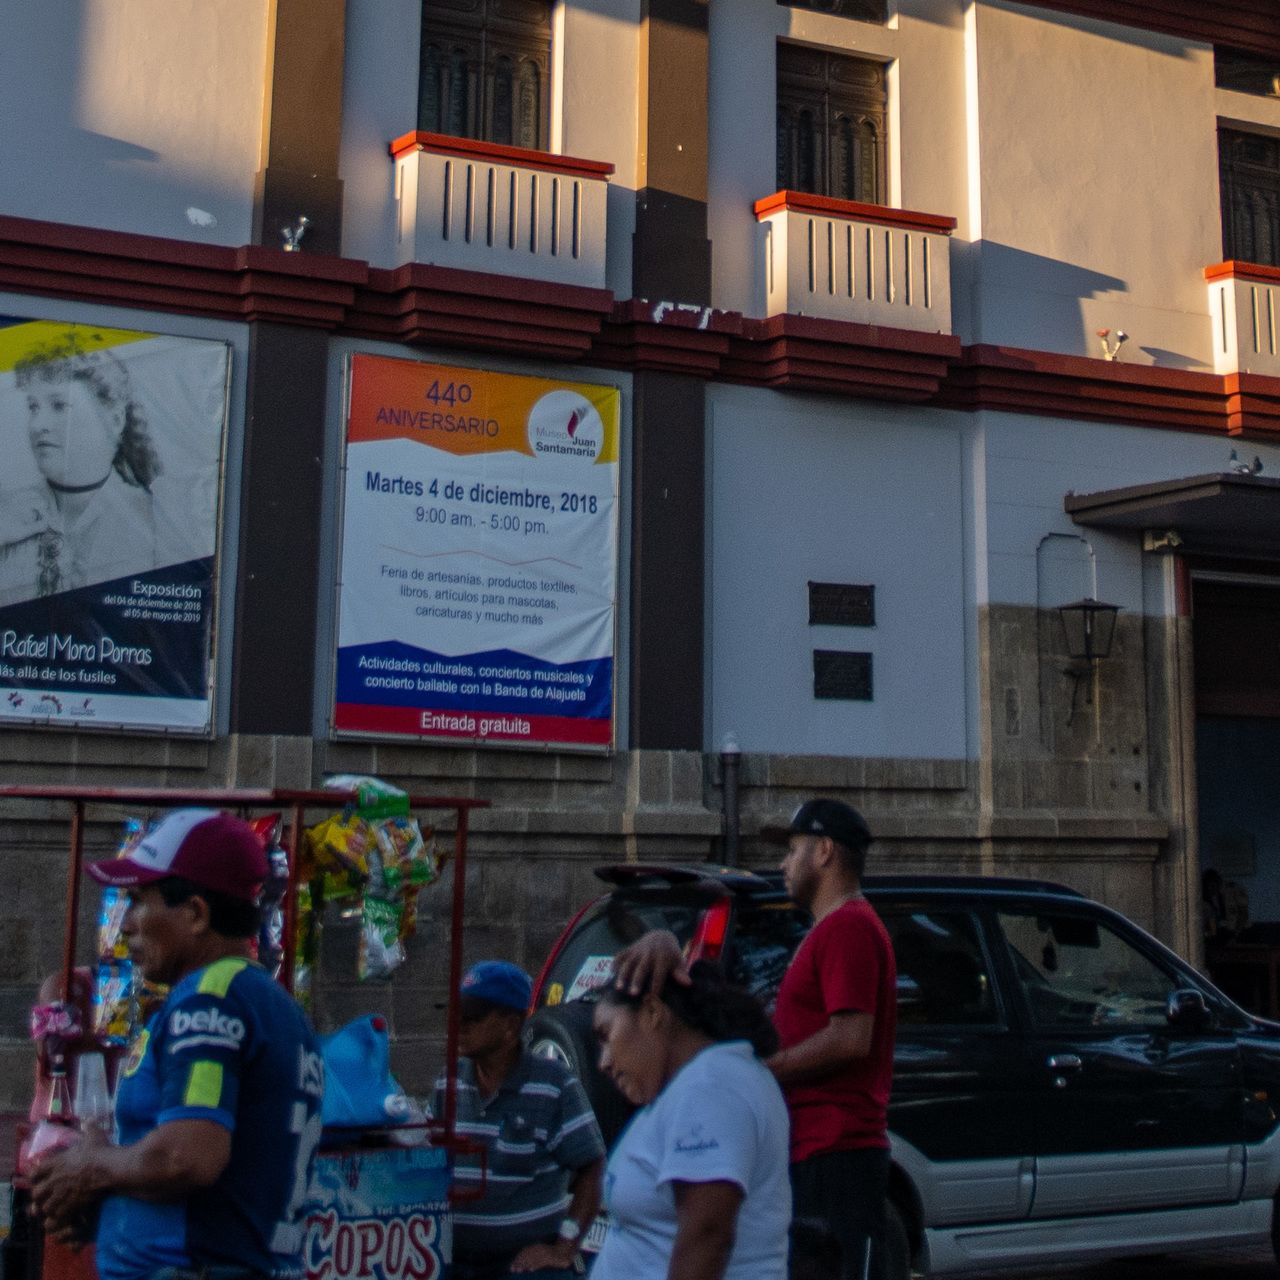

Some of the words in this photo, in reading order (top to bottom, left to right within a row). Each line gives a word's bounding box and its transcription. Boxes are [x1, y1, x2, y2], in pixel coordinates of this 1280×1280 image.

[375, 407, 500, 438] ANIVERSARIO
[536, 426, 569, 441] Museo
[535, 441, 597, 458] Santamaría
[572, 435, 597, 448] Juan
[366, 471, 425, 497] Martes
[429, 478, 440, 498] 4
[444, 480, 465, 501] de
[469, 483, 556, 514] diciembre,
[560, 492, 599, 515] 2018
[415, 506, 447, 524] 9:00
[451, 512, 477, 528] am.
[490, 514, 521, 532] 5:00
[524, 518, 550, 536] pm.
[132, 580, 202, 599] Exposición
[380, 565, 408, 580] Feria
[411, 567, 424, 580] de
[488, 573, 538, 590] productos
[541, 577, 579, 595] textiles,
[104, 595, 116, 605] del
[117, 596, 126, 605] 04
[127, 597, 137, 606] de
[138, 598, 173, 609] diciembre
[174, 600, 183, 609] de
[184, 601, 201, 611] 2018
[400, 585, 432, 600] libros,
[482, 593, 505, 607] para
[508, 596, 560, 612] mascotas,
[122, 608, 131, 618] al
[142, 610, 152, 619] de
[153, 612, 172, 623] mayo
[173, 612, 182, 620] de
[183, 613, 201, 622] 2019
[416, 604, 473, 621] caricaturas
[476, 611, 483, 624] y
[485, 610, 520, 624] mucho
[522, 614, 544, 626] más
[1, 630, 49, 659] Rafael
[52, 633, 96, 662] Mora
[99, 637, 153, 666] Porras
[17, 665, 40, 679] allá
[41, 668, 57, 680] de
[59, 668, 78, 682] los
[79, 669, 118, 685] fusiles
[358, 656, 420, 673] Actividades
[423, 661, 477, 678] culturales,
[480, 665, 532, 682] conciertos
[534, 669, 585, 684] musicales
[587, 673, 594, 687] y
[365, 675, 415, 691] concierto
[417, 678, 458, 694] bailable
[460, 683, 480, 695] con
[482, 682, 492, 695] la
[494, 683, 527, 699] Banda
[530, 686, 544, 699] de
[545, 688, 587, 703] Alajuela
[422, 711, 476, 733] Entrada
[479, 717, 531, 736] gratuita
[169, 1006, 247, 1041] beko
[304, 1210, 441, 1280] COPOS
